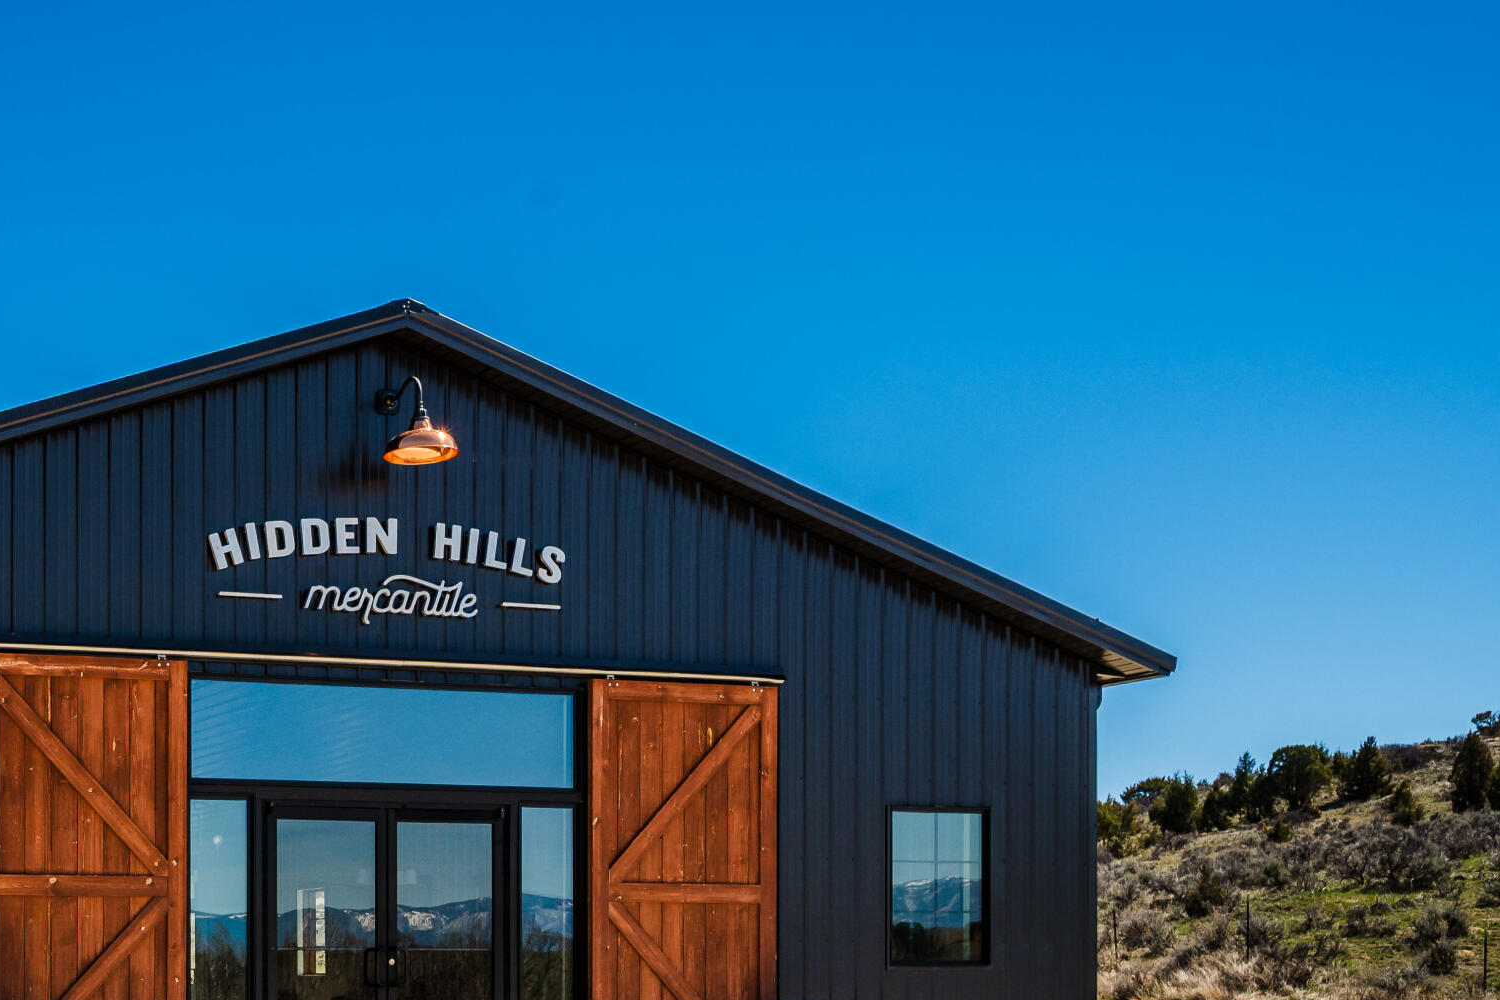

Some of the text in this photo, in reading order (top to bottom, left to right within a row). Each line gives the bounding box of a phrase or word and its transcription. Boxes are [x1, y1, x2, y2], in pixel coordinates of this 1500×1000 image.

[208, 516, 566, 584] HIDDEN HILLS
[304, 574, 479, 625] mercantile
